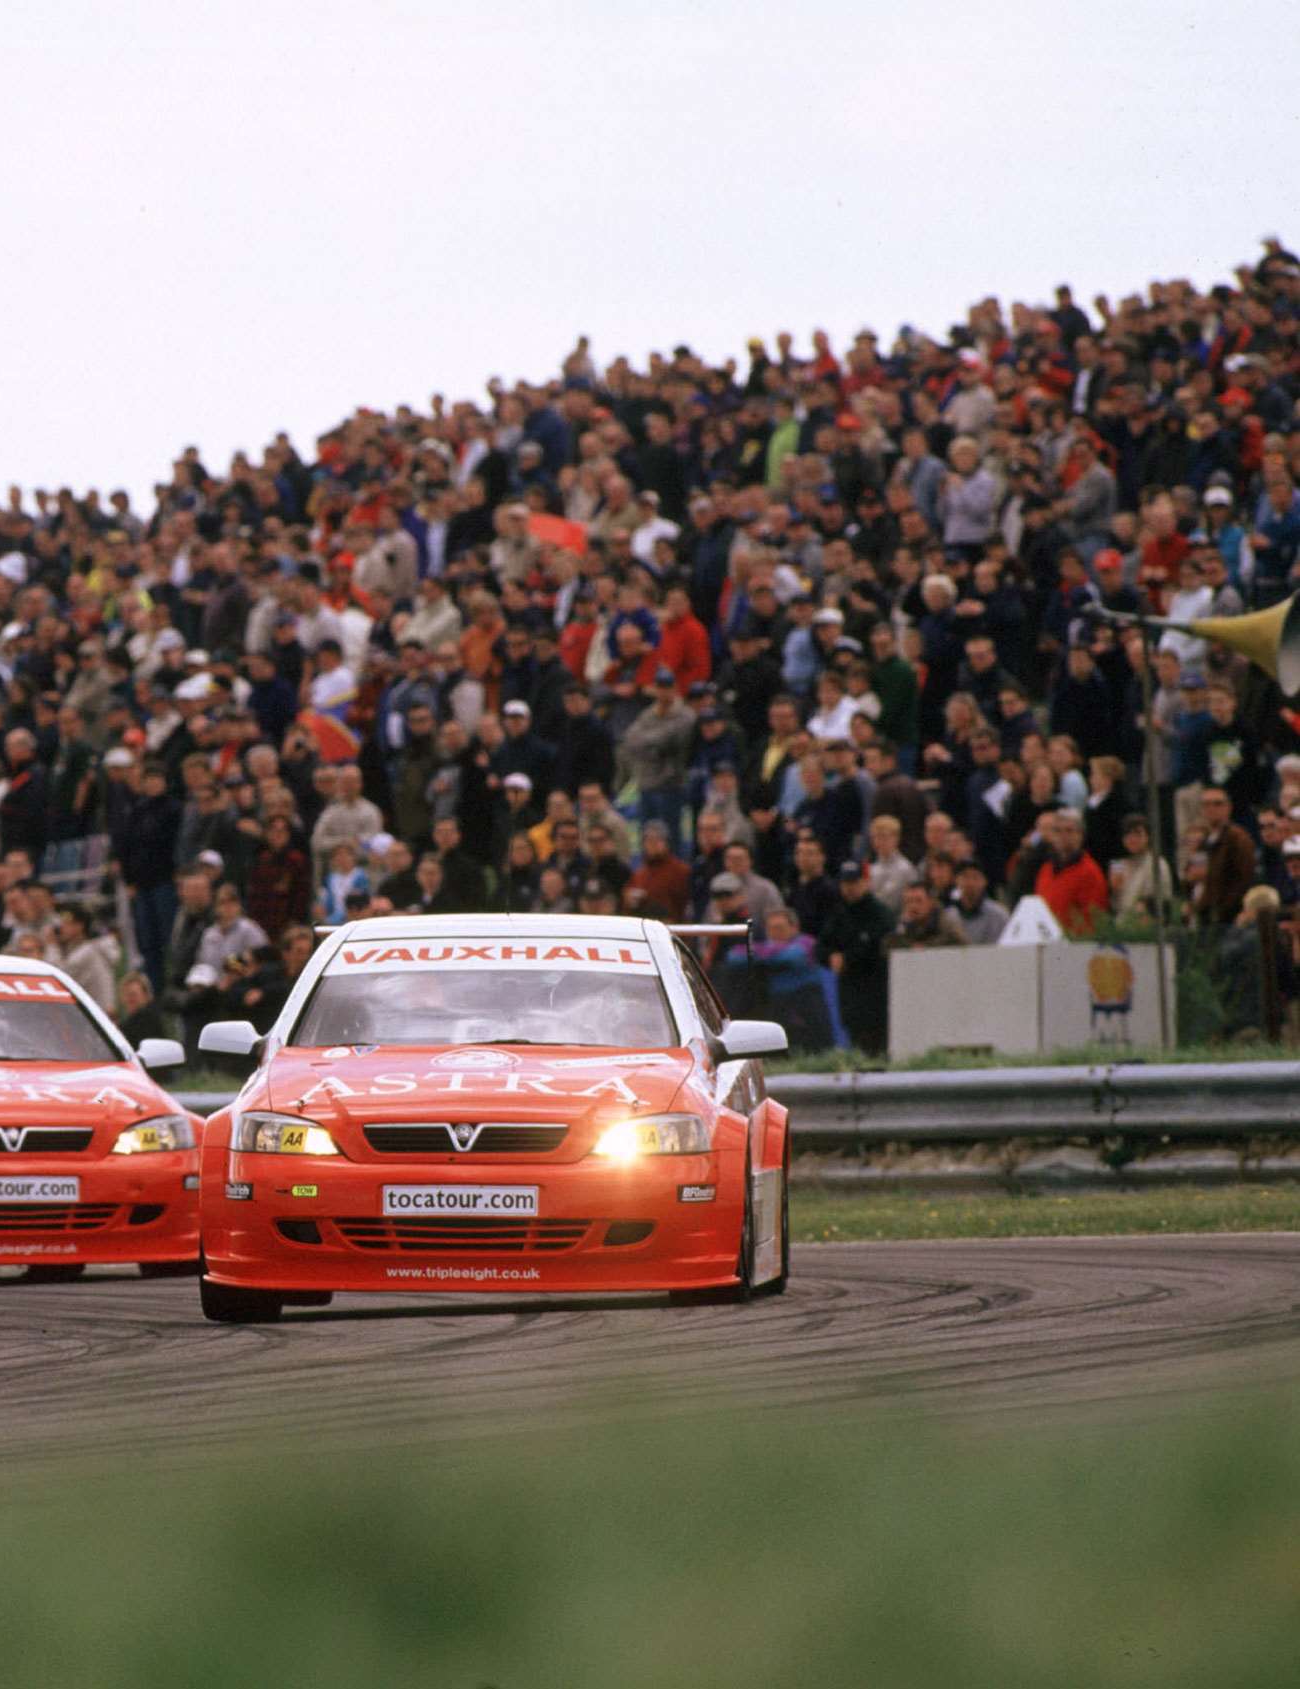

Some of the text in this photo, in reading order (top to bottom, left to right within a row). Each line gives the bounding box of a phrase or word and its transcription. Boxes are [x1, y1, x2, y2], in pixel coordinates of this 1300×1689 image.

[342, 945, 651, 965] VAUXHALL
[289, 1072, 651, 1106] ASTRA
[284, 1131, 304, 1146] AA
[387, 1190, 535, 1209] tocatour.com
[386, 1266, 541, 1281] www.tripleeight.co.uk
